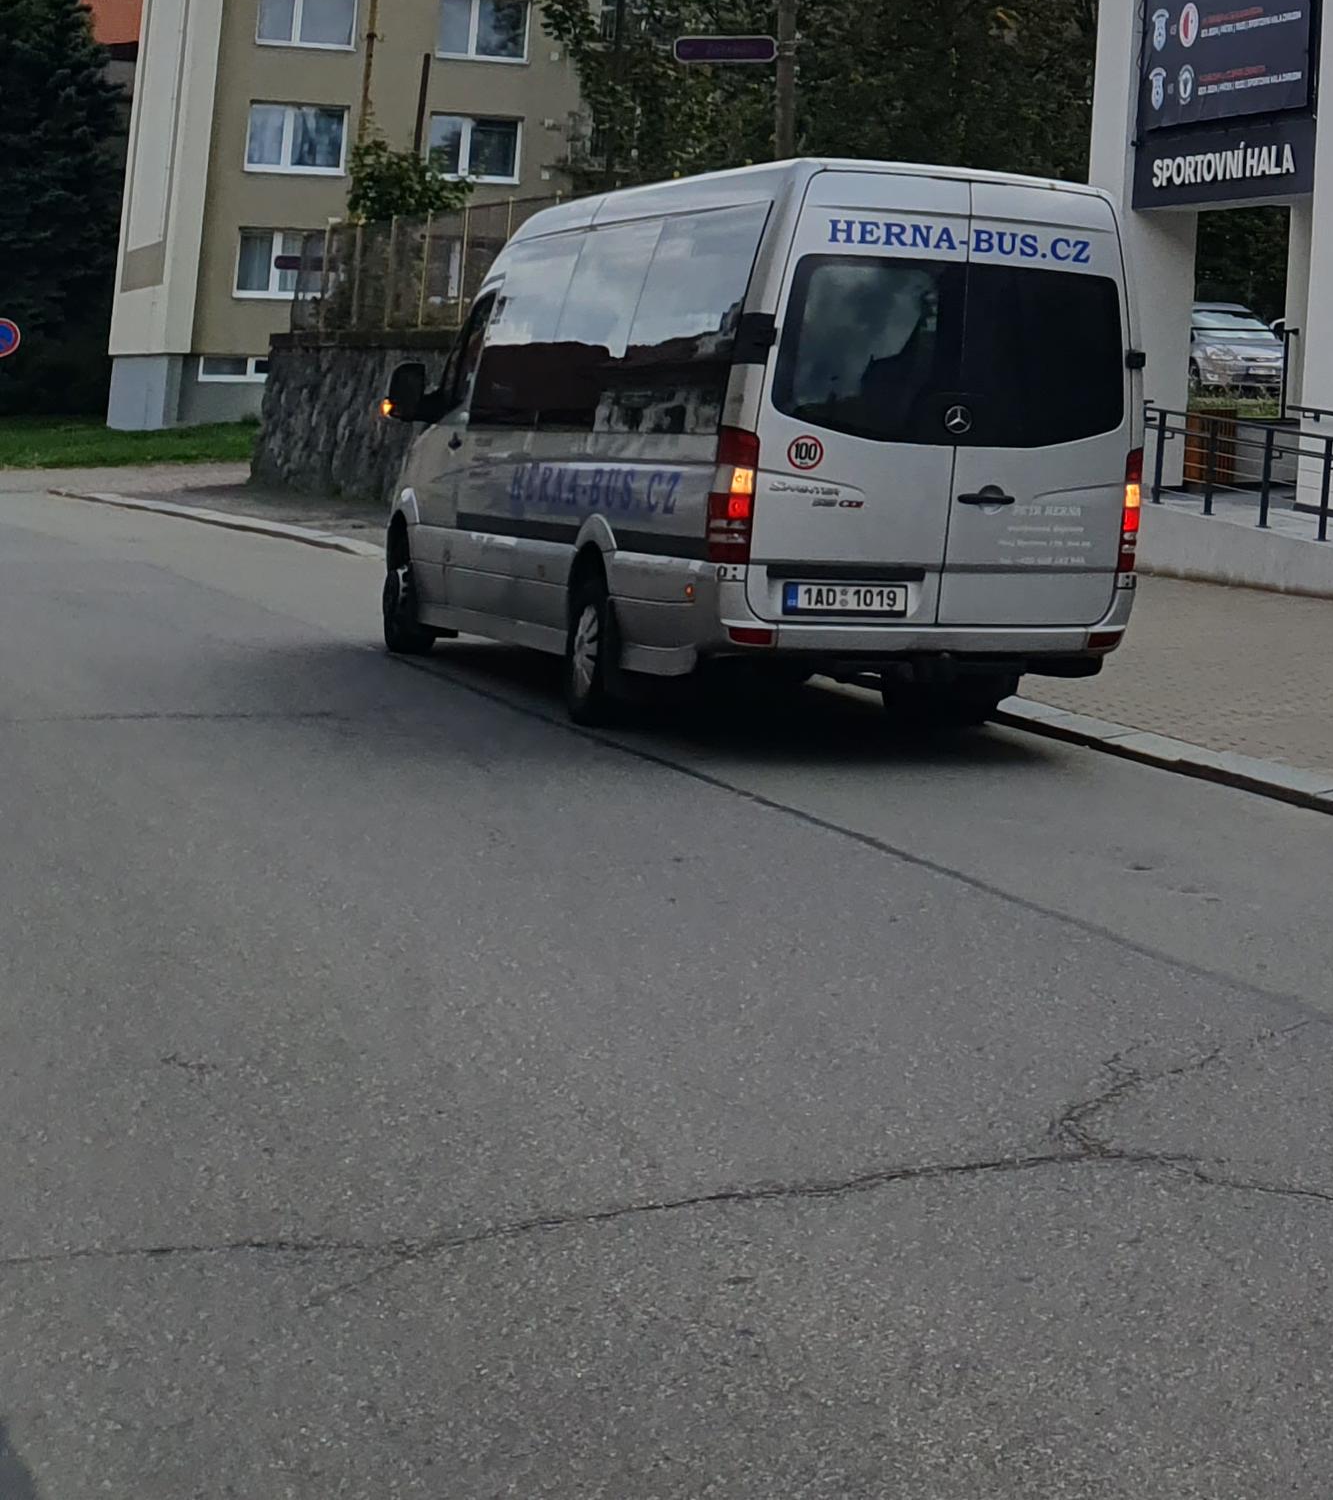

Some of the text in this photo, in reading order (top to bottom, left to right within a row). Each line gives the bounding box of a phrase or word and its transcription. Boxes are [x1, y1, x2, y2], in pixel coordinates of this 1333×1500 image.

[1152, 141, 1295, 188] SPORTOVNÍ HALA
[828, 219, 1091, 264] HERNA-BUS.CZ
[795, 442, 817, 461] 100
[804, 587, 897, 608] 1AD 1019
